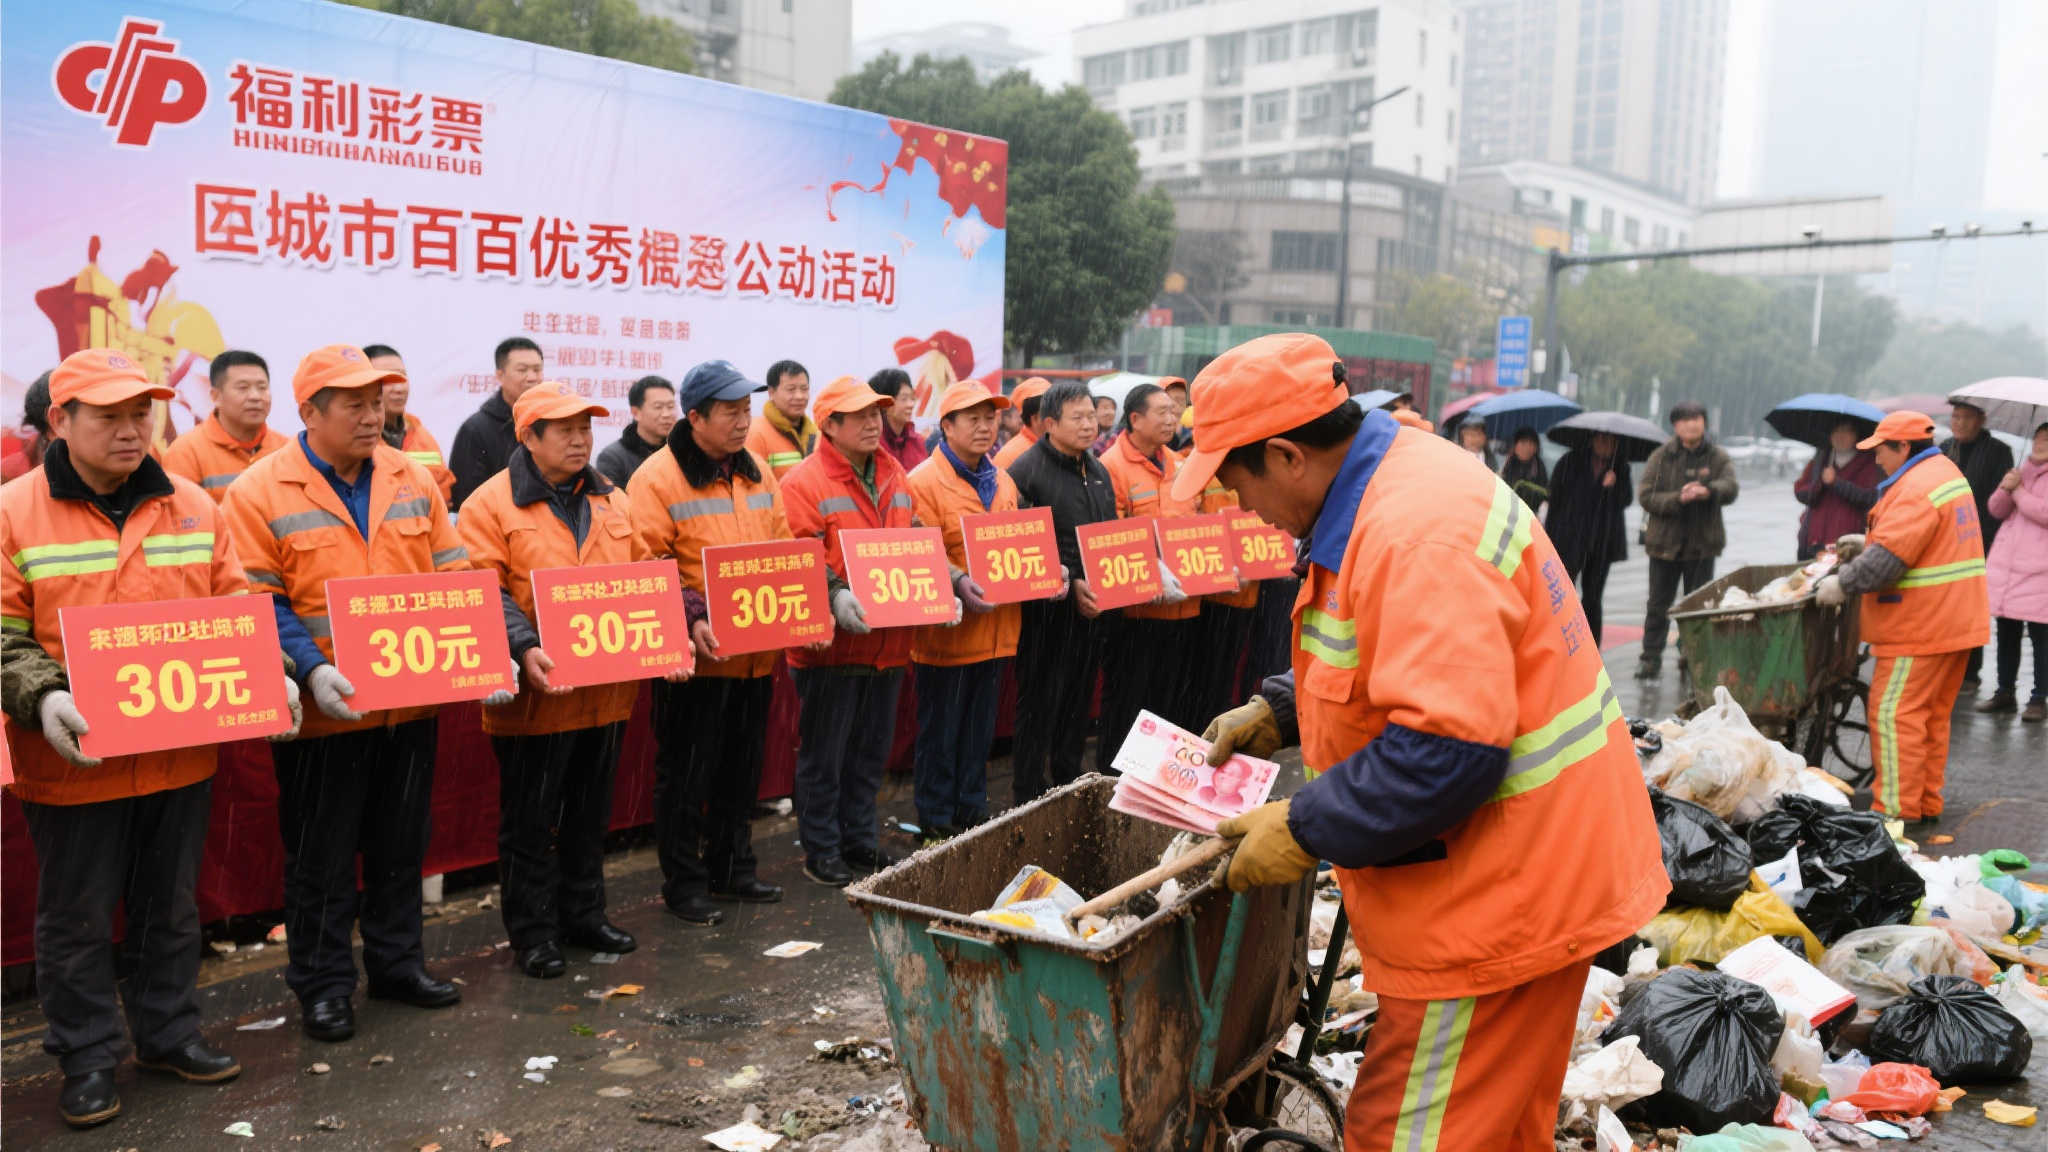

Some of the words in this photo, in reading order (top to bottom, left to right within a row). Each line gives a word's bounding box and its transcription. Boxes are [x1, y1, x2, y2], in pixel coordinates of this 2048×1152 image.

[229, 64, 483, 155] 福利彩票
[986, 546, 1046, 582] 30元
[1177, 547, 1224, 577] 30元
[1242, 535, 1287, 563] 30元
[869, 567, 938, 604] 30元
[1099, 552, 1150, 588] 30元
[732, 584, 810, 628] 30元
[369, 625, 481, 677] 30元
[569, 609, 664, 657] 30元
[116, 657, 251, 718] 30元
